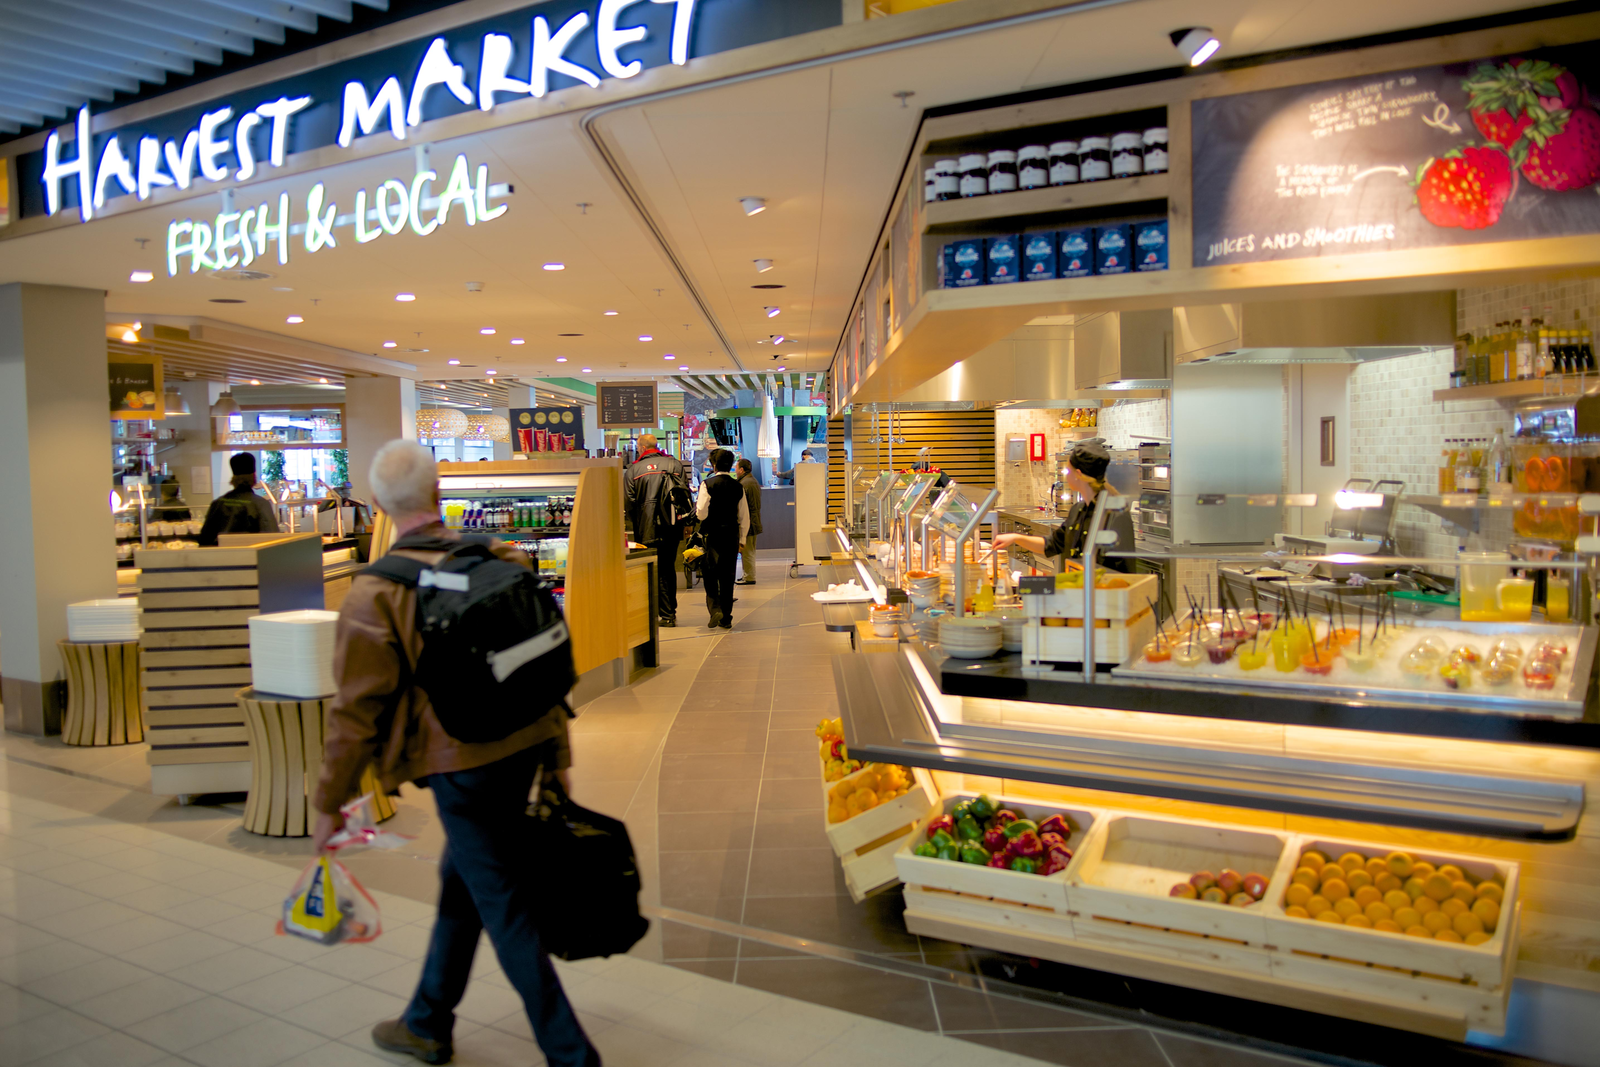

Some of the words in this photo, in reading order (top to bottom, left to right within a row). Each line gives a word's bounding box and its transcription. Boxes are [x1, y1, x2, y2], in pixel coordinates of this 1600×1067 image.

[41, 98, 311, 219] HARVEST
[338, 0, 698, 147] MARKET
[165, 188, 290, 276] FRESH
[304, 181, 338, 252] &
[355, 154, 508, 243] LOCAL
[1207, 234, 1256, 261] JUICES
[1261, 232, 1301, 250] AND
